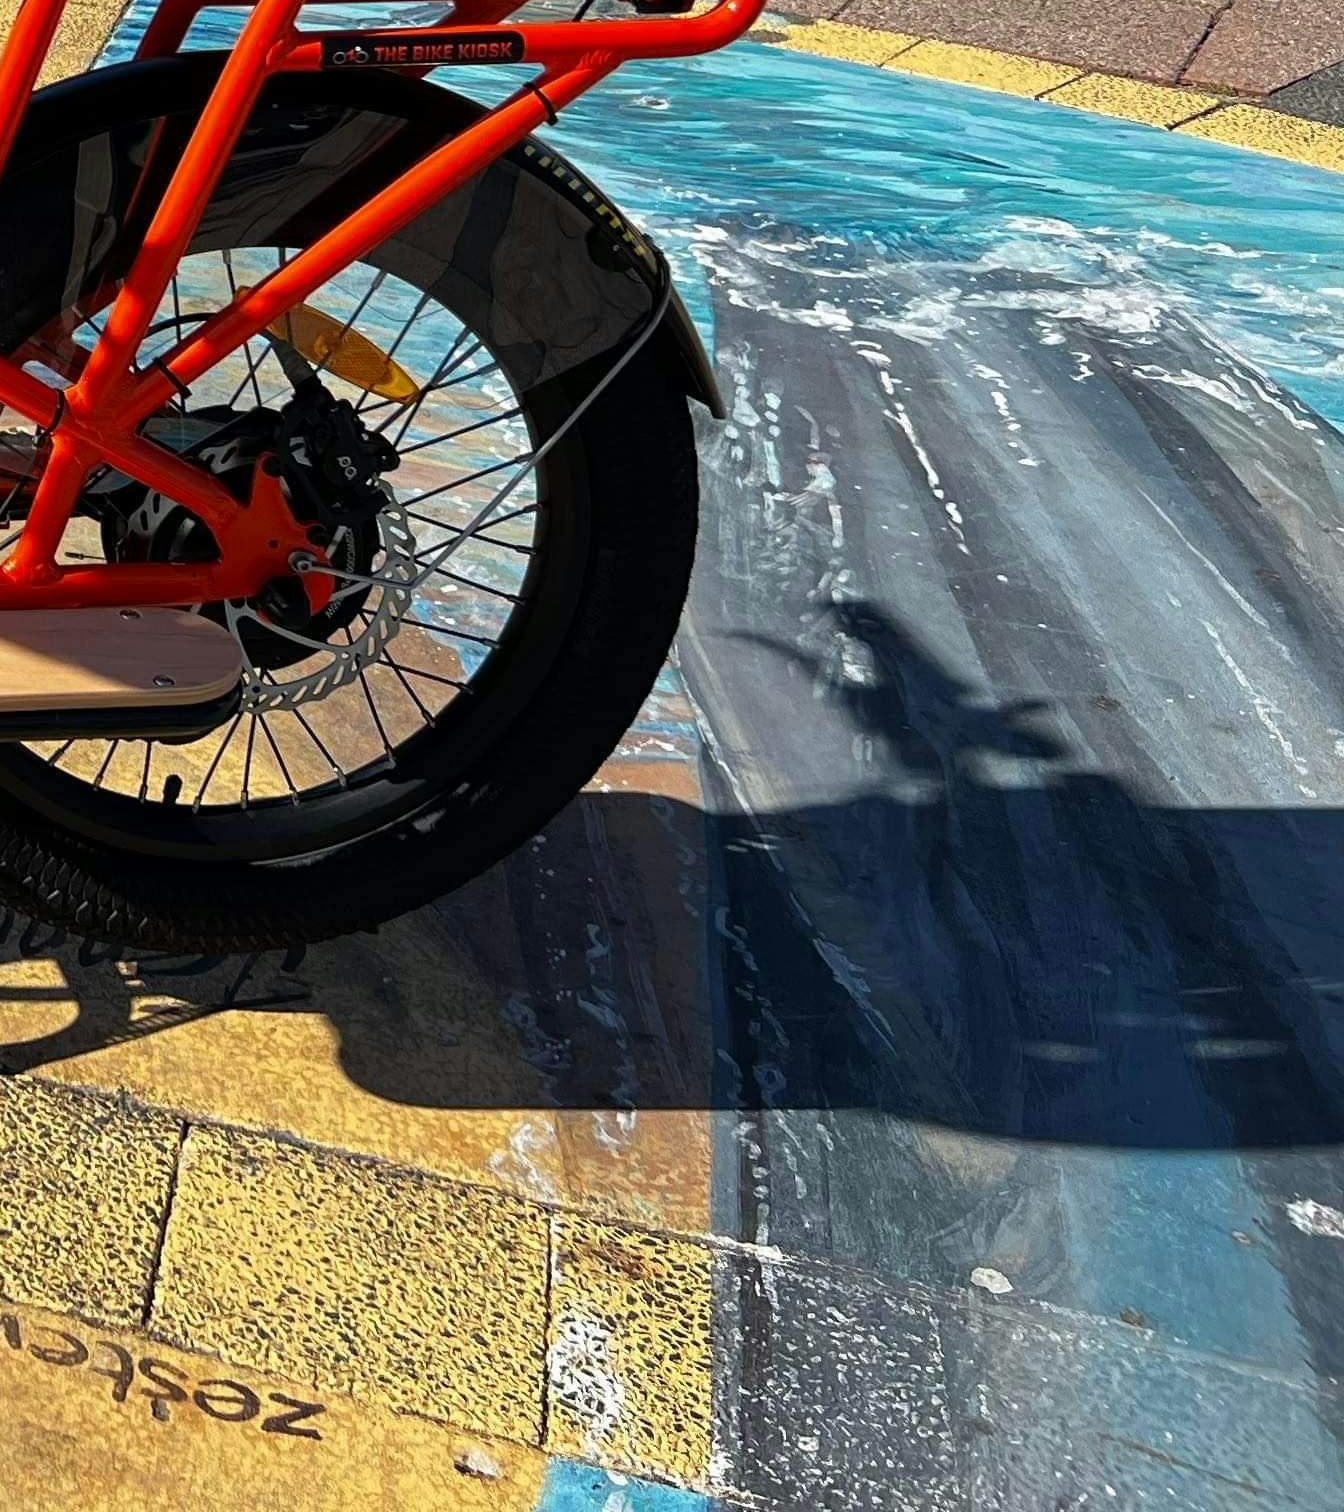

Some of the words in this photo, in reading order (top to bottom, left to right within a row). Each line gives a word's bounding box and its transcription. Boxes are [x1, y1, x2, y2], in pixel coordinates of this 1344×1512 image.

[374, 46, 409, 63] THE
[412, 44, 454, 61] BIKE
[457, 41, 513, 59] KIOSK
